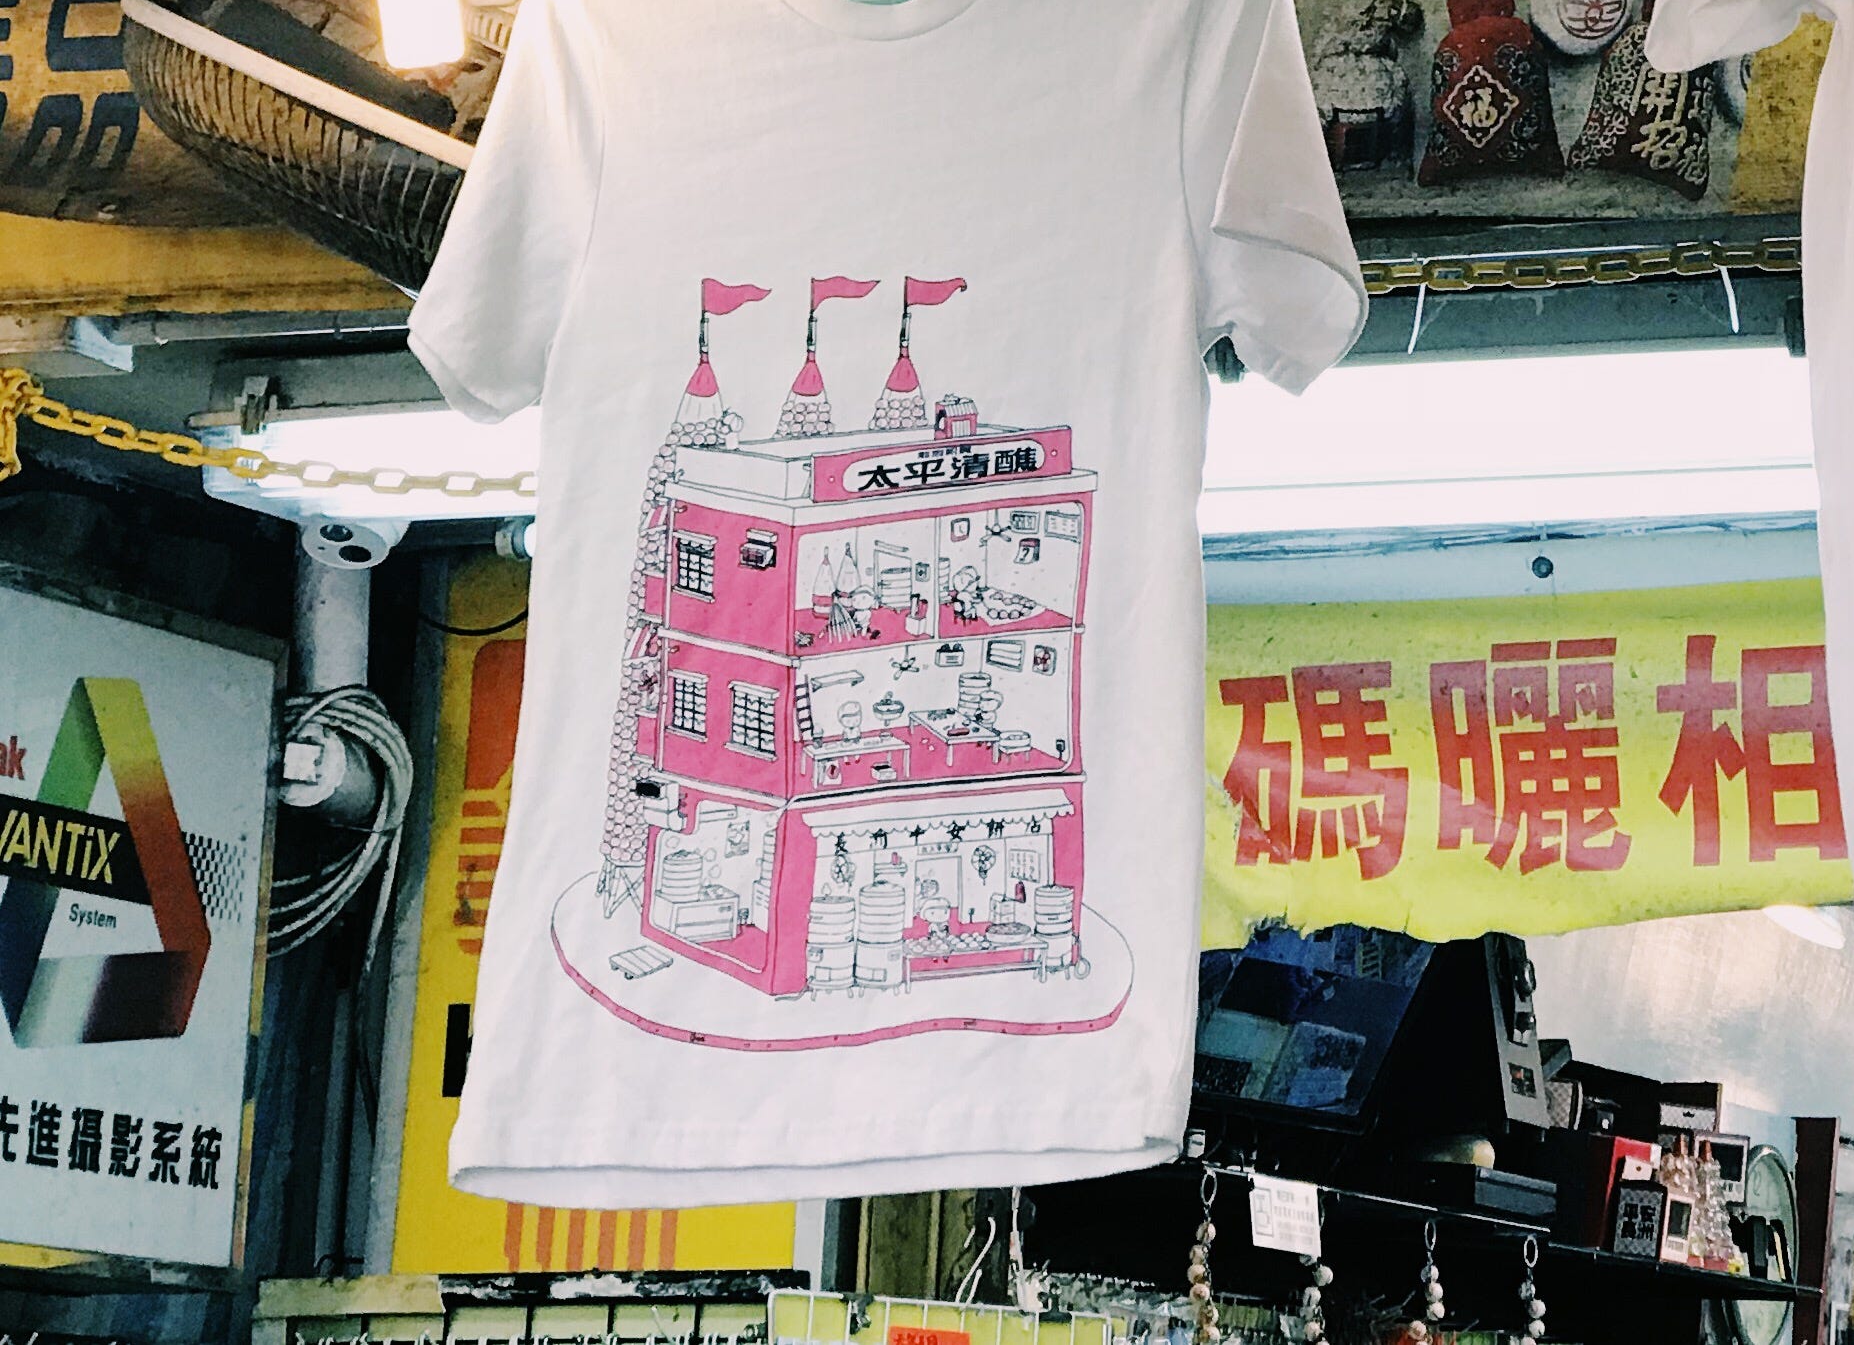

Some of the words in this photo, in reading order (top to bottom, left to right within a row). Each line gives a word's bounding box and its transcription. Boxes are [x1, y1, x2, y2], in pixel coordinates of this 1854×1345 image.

[857, 446, 1037, 492] 太平清醮
[68, 902, 118, 929] System
